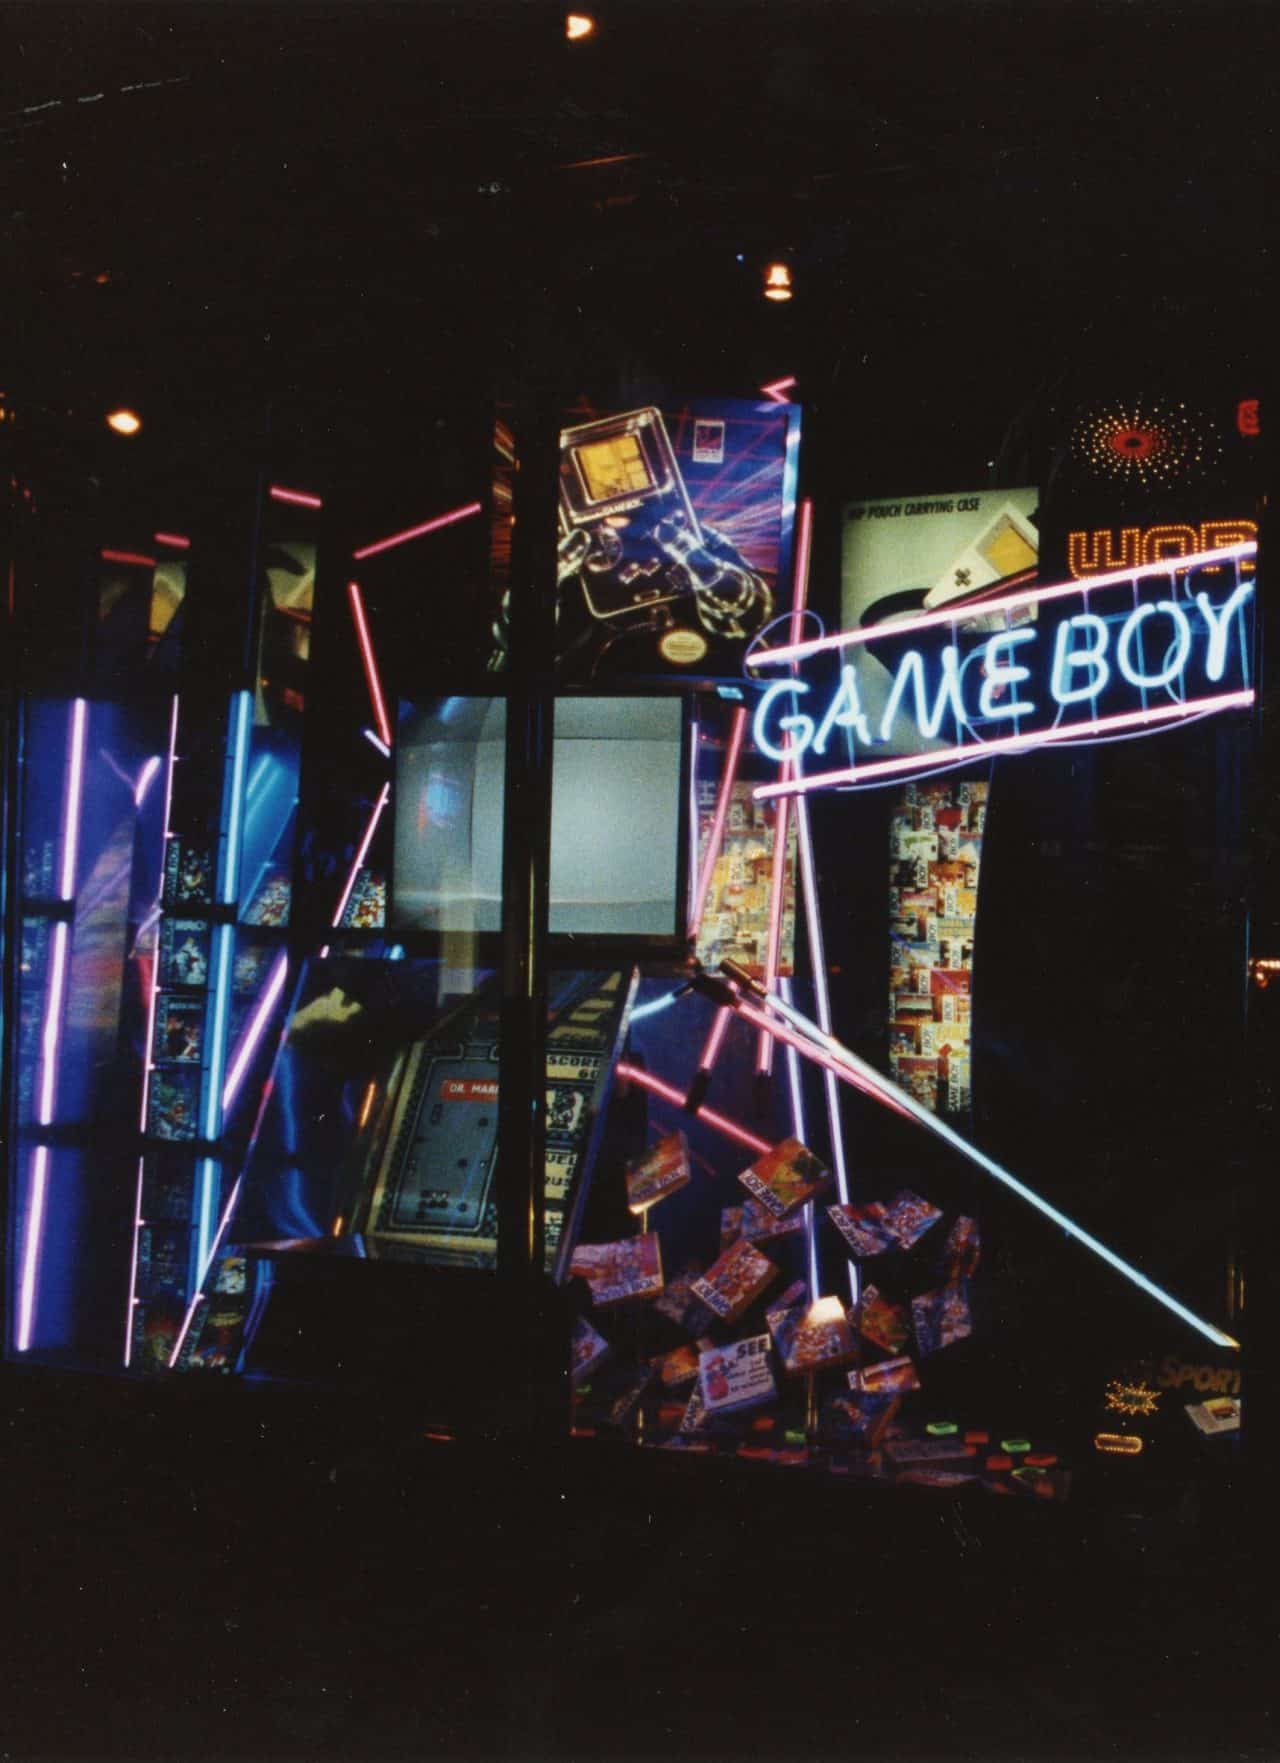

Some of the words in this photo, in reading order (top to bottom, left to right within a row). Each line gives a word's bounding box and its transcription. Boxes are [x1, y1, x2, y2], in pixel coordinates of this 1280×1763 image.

[867, 502, 902, 518] POUCH
[904, 499, 955, 516] CARRYING
[957, 497, 981, 512] CASE
[736, 1336, 771, 1360] SEE
